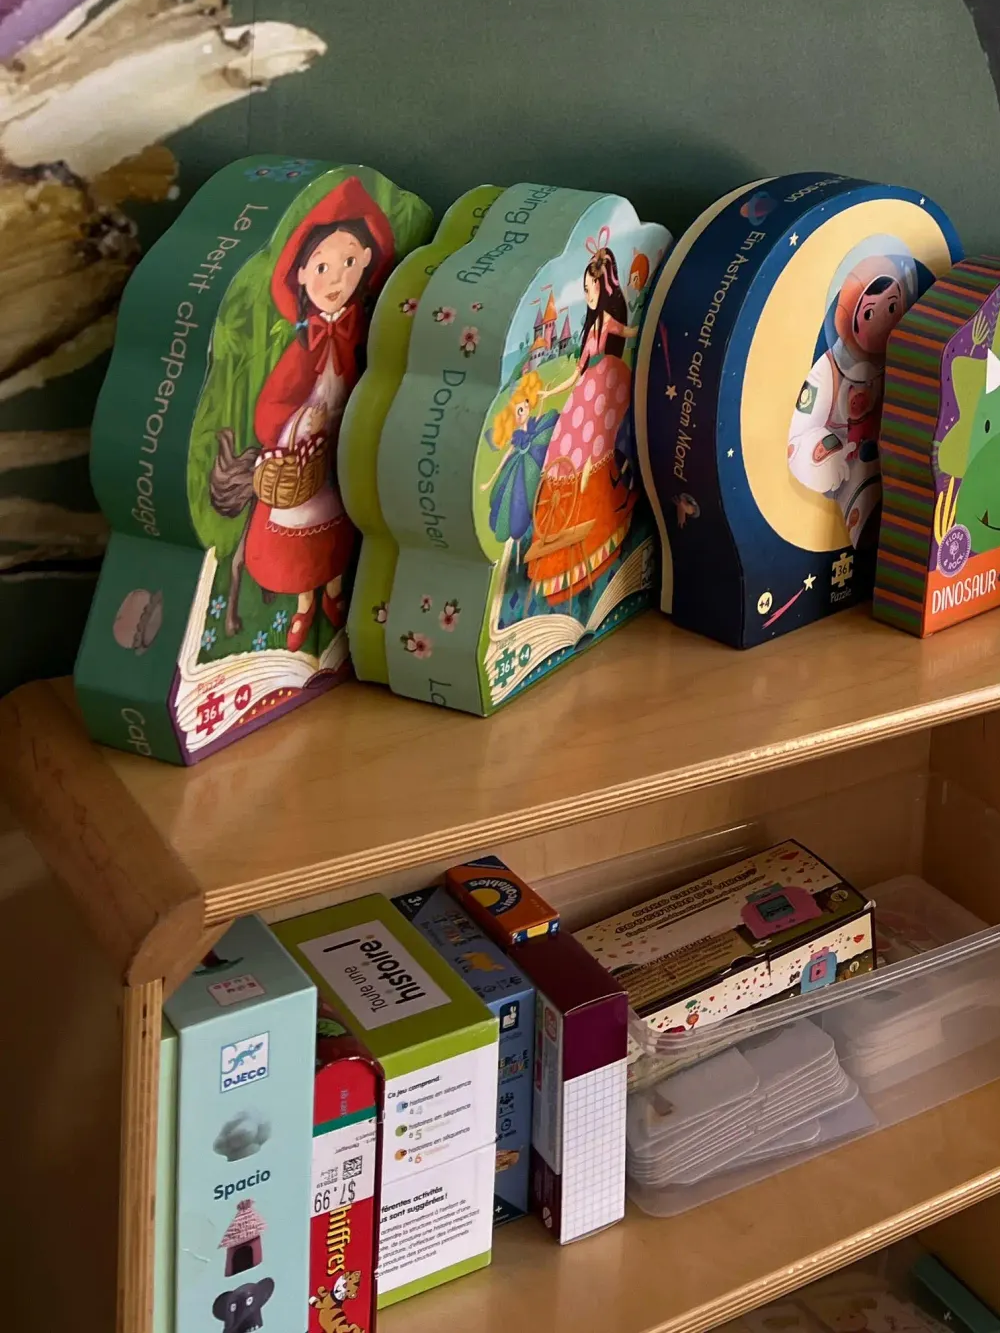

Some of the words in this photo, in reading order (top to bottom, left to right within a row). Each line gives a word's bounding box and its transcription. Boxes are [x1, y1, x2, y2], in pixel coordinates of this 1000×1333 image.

[233, 203, 268, 231] Le
[741, 231, 765, 250] Ein
[188, 236, 241, 294] petit
[457, 231, 530, 284] Beauty
[697, 253, 749, 348] Astronaut
[141, 301, 199, 454] chaperon
[686, 351, 703, 389] auf
[680, 390, 697, 428] dem
[417, 370, 467, 549] Dornröschen
[673, 429, 693, 482] Mond
[131, 460, 161, 537] rouge
[945, 531, 964, 546] FLOSS
[932, 568, 997, 615] DINOSAUR
[499, 660, 510, 677] 36
[236, 690, 249, 704] +4
[203, 706, 217, 723] 36
[616, 935, 713, 982] ARNING/AVERTISSEMENT
[344, 966, 367, 985] une
[360, 985, 388, 1013] Toute
[224, 1066, 266, 1088] DJECO
[397, 1089, 407, 1097] jeu
[214, 1170, 271, 1200] Spacio
[314, 1178, 356, 1213] $7.99
[381, 1198, 412, 1213] férentes
[413, 1186, 443, 1202] activités
[389, 1210, 406, 1220] sont
[407, 1194, 445, 1214] suggérées
[327, 1205, 353, 1277] hiffres
